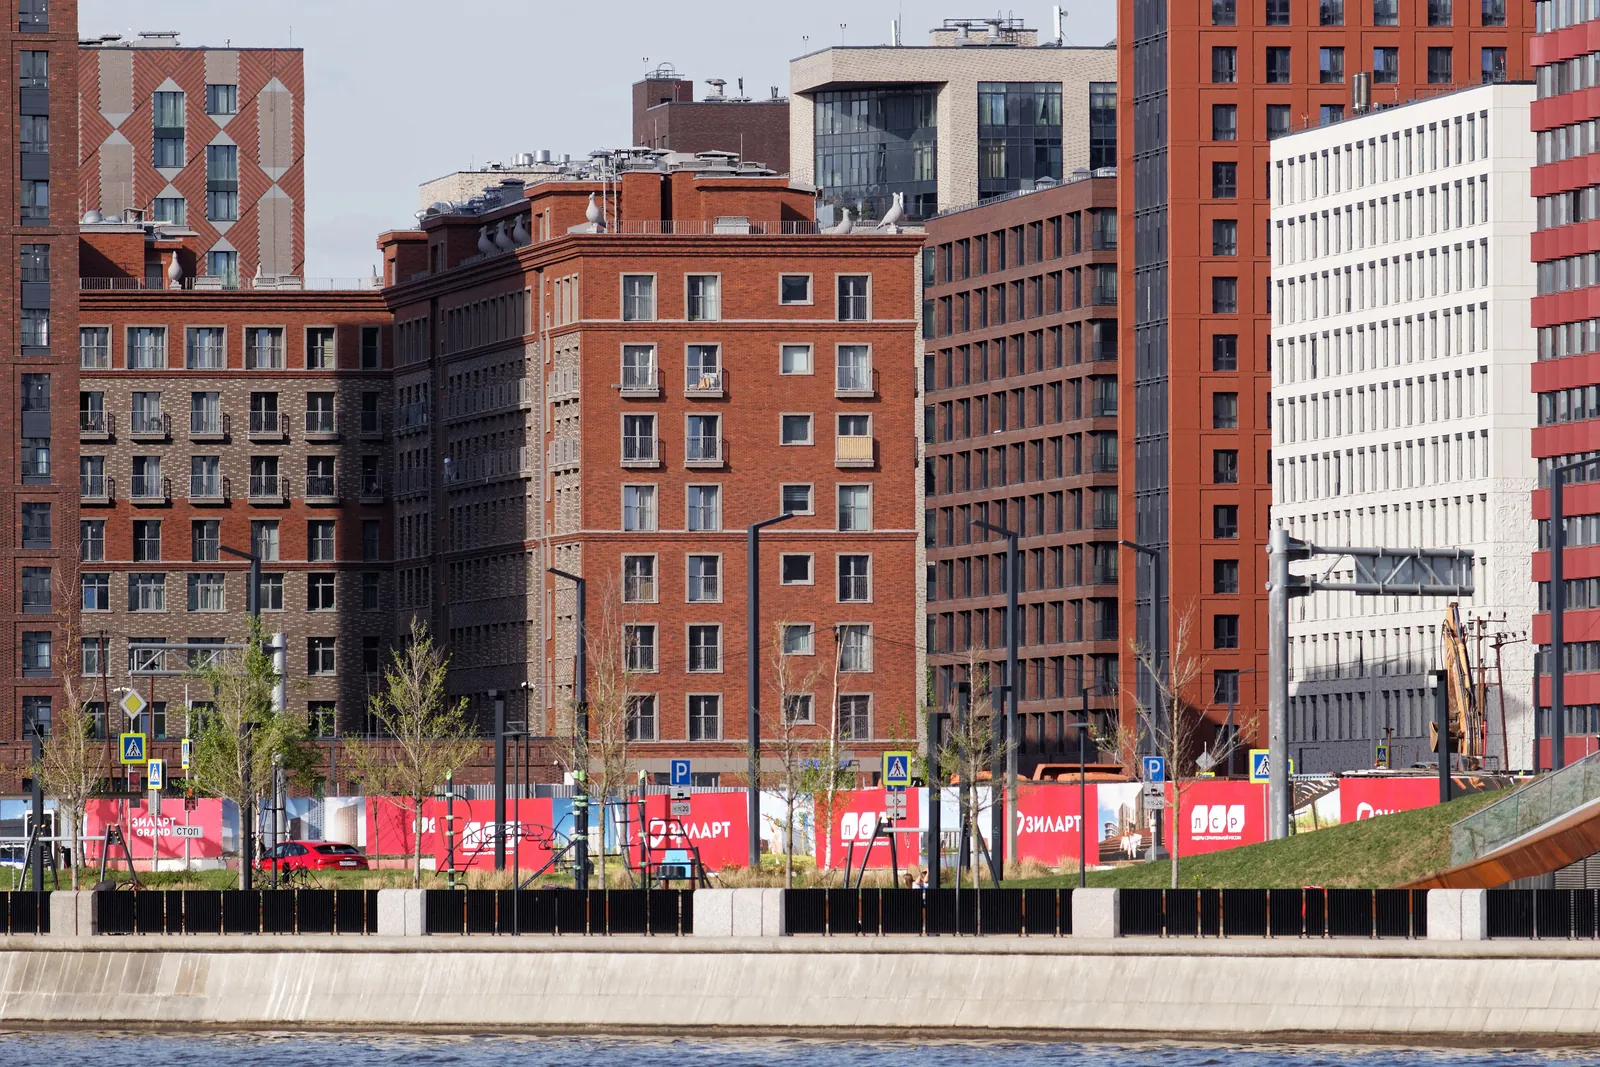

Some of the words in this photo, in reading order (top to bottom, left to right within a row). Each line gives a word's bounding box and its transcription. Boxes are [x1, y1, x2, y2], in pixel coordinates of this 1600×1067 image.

[676, 762, 687, 783] P
[1149, 760, 1160, 780] P
[176, 827, 199, 835] СТОП
[1025, 815, 1081, 833] ЗИЛАРТ
